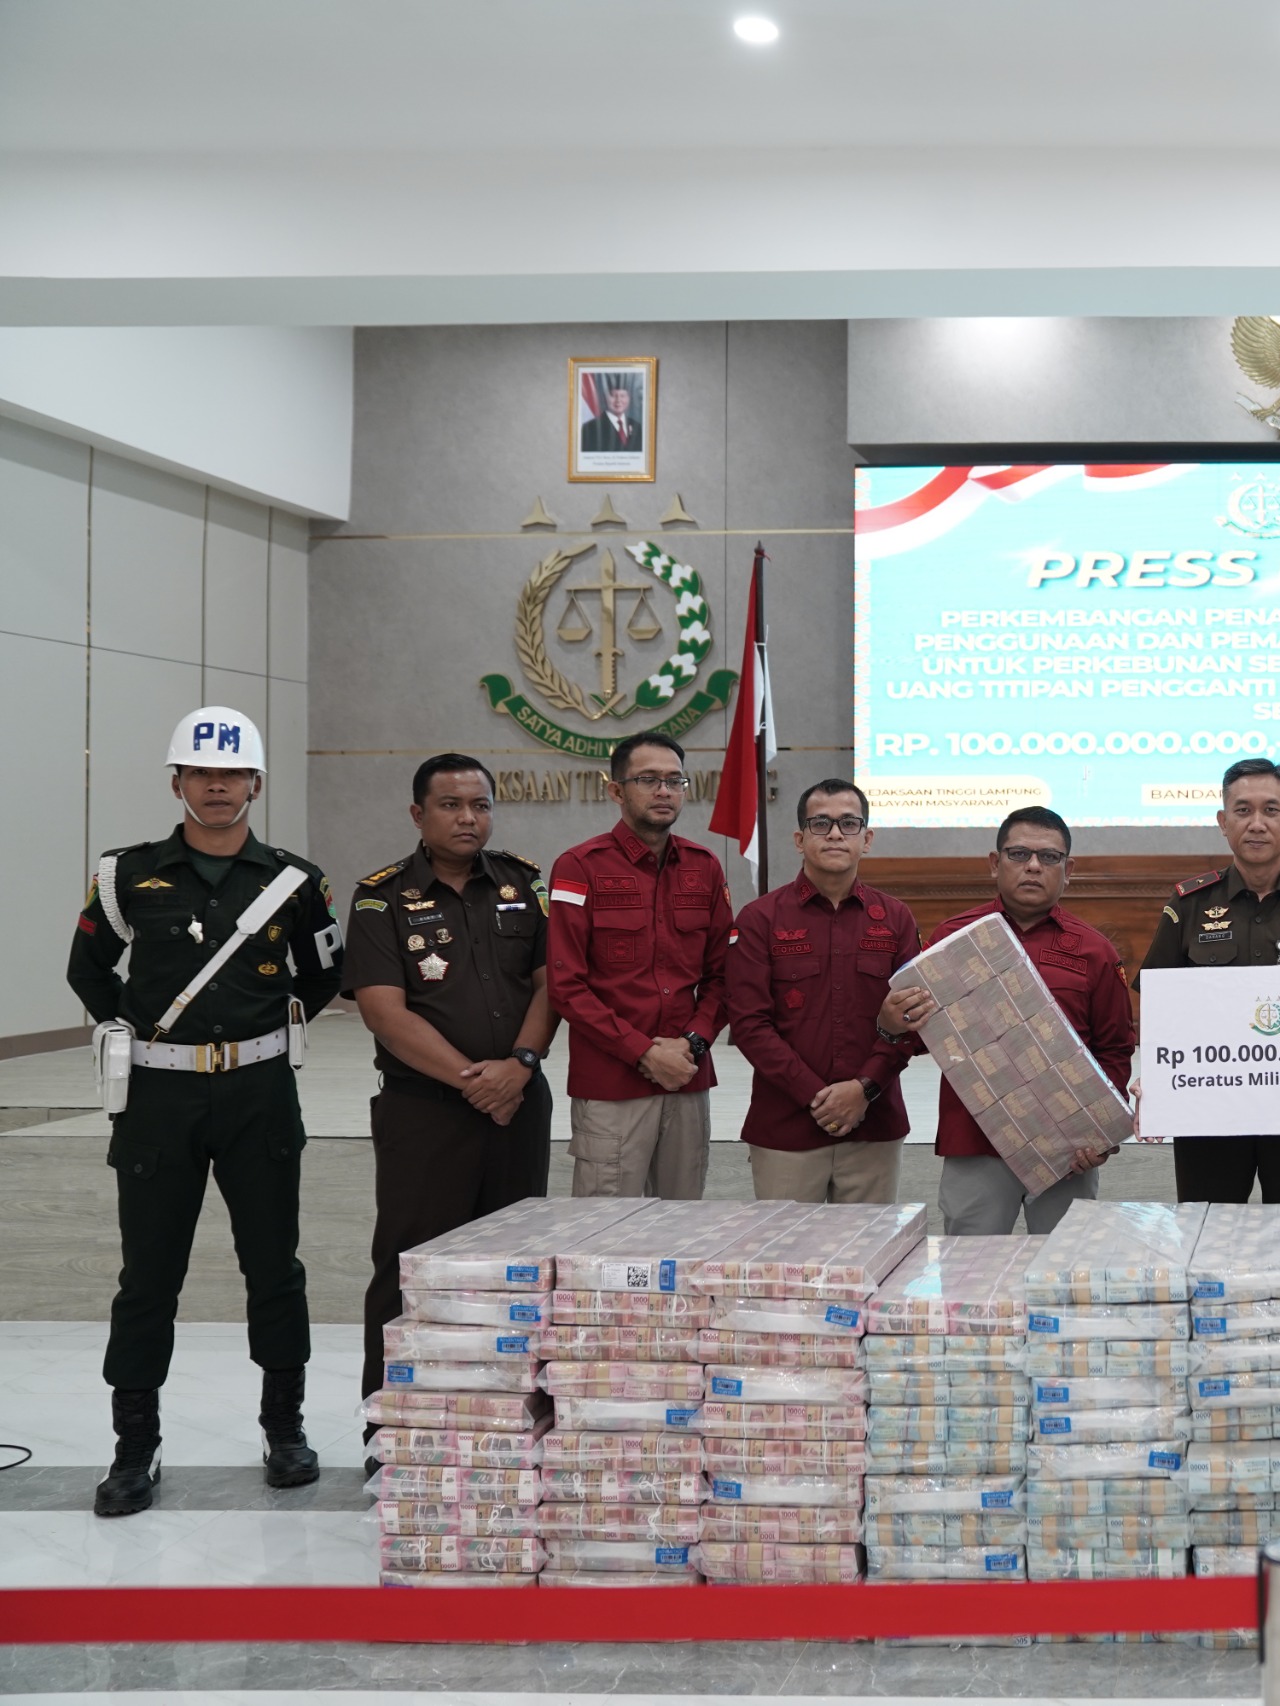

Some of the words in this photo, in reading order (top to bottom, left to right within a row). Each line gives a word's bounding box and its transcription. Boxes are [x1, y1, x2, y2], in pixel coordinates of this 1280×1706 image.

[1027, 550, 1257, 588] PRESS
[941, 609, 1197, 628] PERKEMBANGAN
[915, 633, 1129, 652] PENGGUNAAN
[1137, 632, 1203, 650] DAN
[922, 657, 1027, 675] UNTUK
[1033, 655, 1242, 674] PERKEBUNAN
[886, 681, 974, 699] UANG
[978, 680, 1094, 698] TITIPAN
[1101, 679, 1276, 698] PENGGANTI
[193, 722, 241, 754] PM
[515, 706, 561, 747] SATYA
[563, 735, 603, 755] ADHI
[875, 733, 940, 756] RP.
[936, 788, 977, 796] TINGGI
[980, 787, 1041, 796] LAMPUNG
[926, 799, 1010, 807] MASYARAKAT
[1156, 1047, 1184, 1069] Rp
[1171, 1073, 1243, 1090] (Seratus
